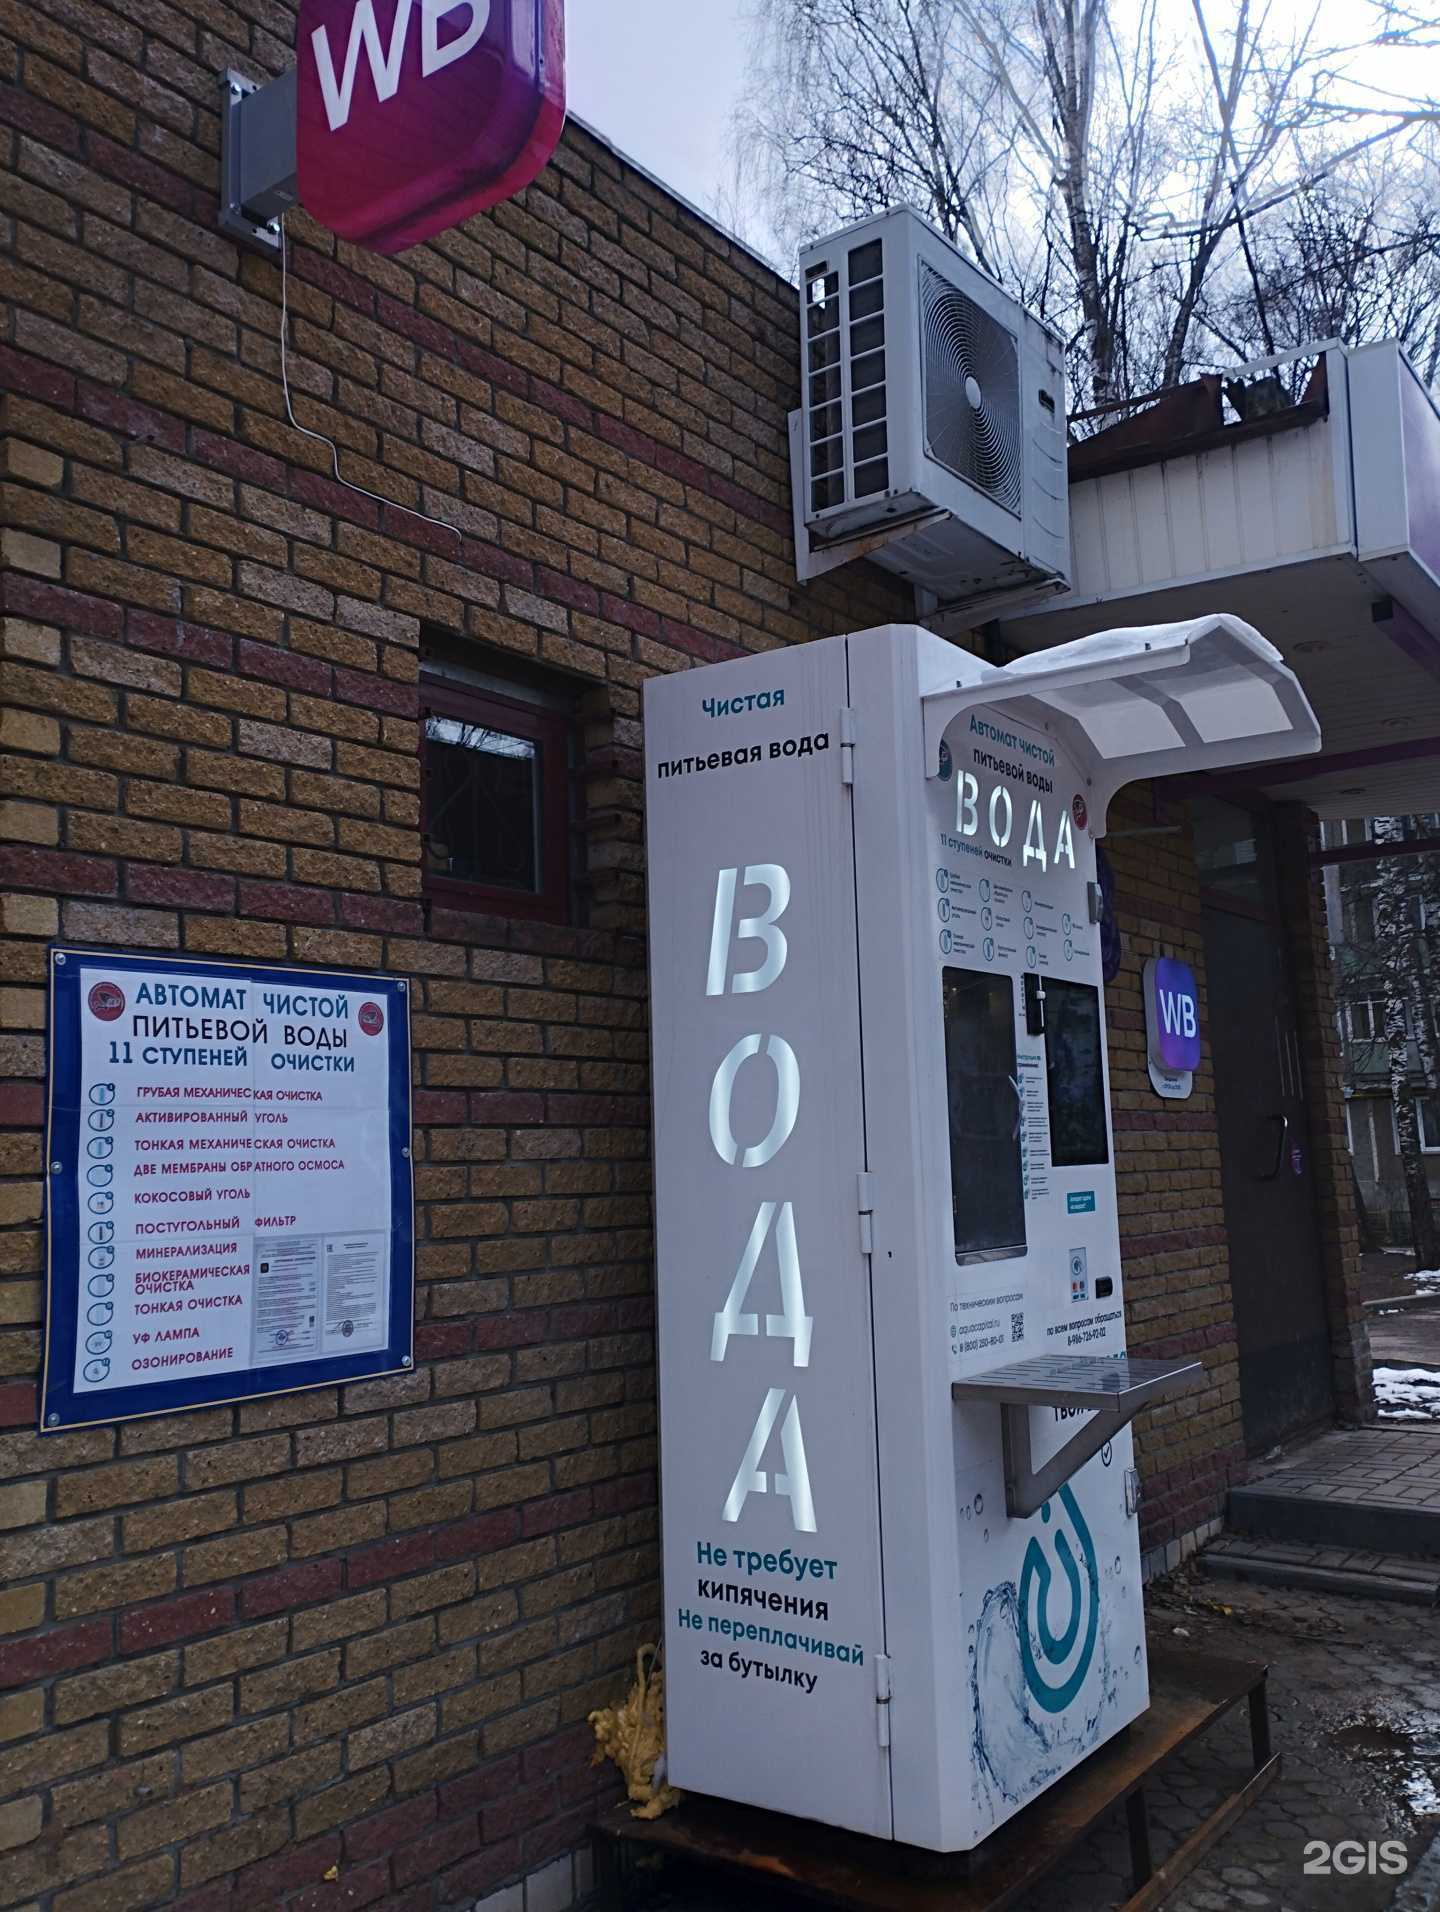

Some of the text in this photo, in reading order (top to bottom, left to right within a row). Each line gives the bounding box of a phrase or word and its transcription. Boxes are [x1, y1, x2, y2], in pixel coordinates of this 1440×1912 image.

[702, 689, 785, 717] Чистая
[969, 714, 1055, 767] Автомат чистой
[658, 733, 829, 778] питьевая вода
[973, 748, 1053, 793] питьевой воды
[956, 769, 1076, 873] ВОДА
[136, 982, 247, 1010] АВТОМАТ
[263, 992, 349, 1019] ЧИСТОЙ
[1159, 988, 1197, 1038] WB
[133, 1015, 347, 1051] ПИТЬЕВОЙ ВОДЫ
[108, 1041, 355, 1073] 11 СТУПЕНЕЙ ОЧИСТКИ
[136, 1086, 323, 1101] ГРУБАЯ МЕХАНИЧЕСКАЯ ОЧИСТКА
[135, 1110, 289, 1124] АКТИВИРОВАННЫЙ УГОЛЬ
[134, 1138, 336, 1151] ТОНКАЯ МЕХАНИЧЕСКАЯ ОЧИСТКА
[133, 1159, 345, 1177] ДВЕ МЕМБРАНЫ ОБРАТНОГО ОСМОСА
[134, 1188, 251, 1204] КОКОСОВЫЙ УГОЛЬ
[705, 863, 817, 1533] ВОДА
[135, 1216, 297, 1235] ПОСТУГОЛЬНЫЙ ФИЛЬТР
[136, 1242, 238, 1260] МИНЕРАЛИЗАЦИЯ
[135, 1264, 250, 1284] БИОКЕРАМИЧЕСКАЯ
[135, 1280, 195, 1296] ОЧИСТКА
[134, 1294, 243, 1316] ТОНКАЯ ОЧИСТКА
[132, 1327, 200, 1345] УФ ЛАМПА
[1069, 1317, 1094, 1331] вопросам
[131, 1347, 234, 1371] ОЗОНИРОВАНИЕ
[697, 1541, 837, 1581] Не требует
[698, 1579, 828, 1621] кипячения
[678, 1608, 864, 1666] Не переплачивай
[700, 1650, 818, 1694] за бутылку
